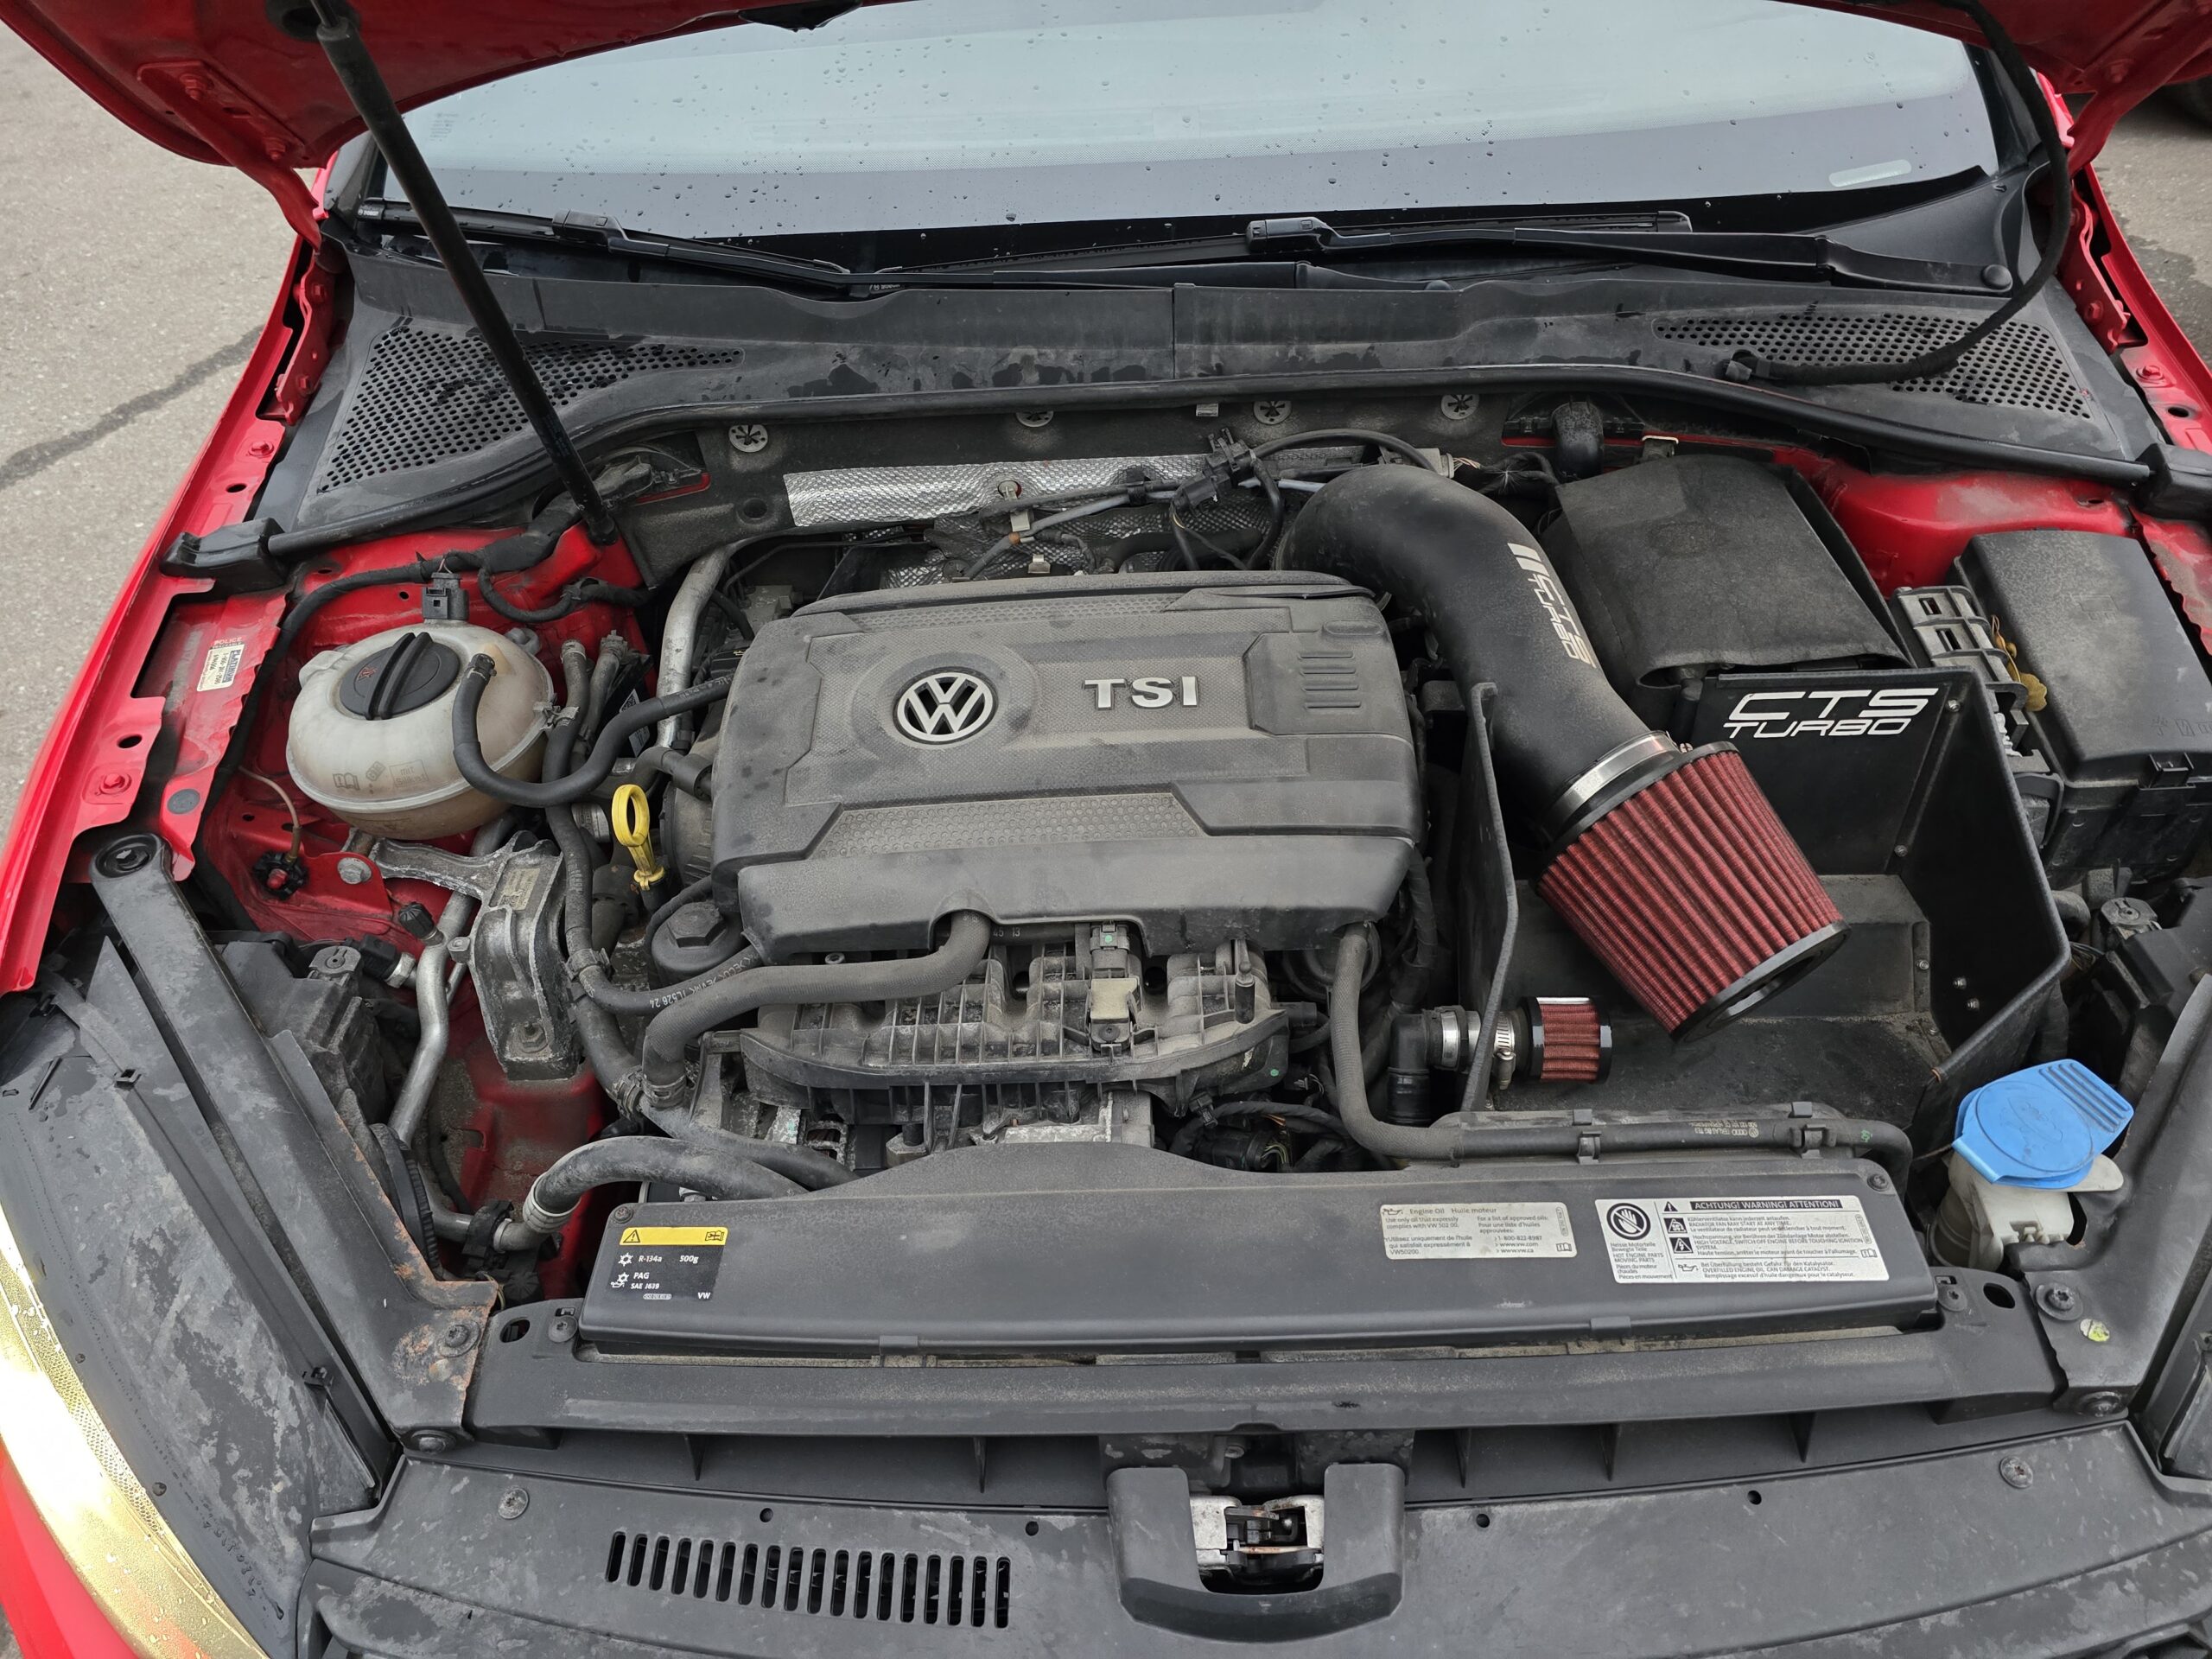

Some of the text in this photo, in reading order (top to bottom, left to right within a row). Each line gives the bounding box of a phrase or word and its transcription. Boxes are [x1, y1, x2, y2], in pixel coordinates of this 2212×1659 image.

[1528, 573, 1580, 659] TURBO
[1537, 575, 1597, 669] CTS
[214, 637, 242, 645] POLICE
[897, 672, 993, 742] VW
[1084, 676, 1198, 709] TSI
[1729, 688, 1939, 720] CTS
[1723, 718, 1911, 739] TURBO
[679, 1255, 699, 1263] 500g
